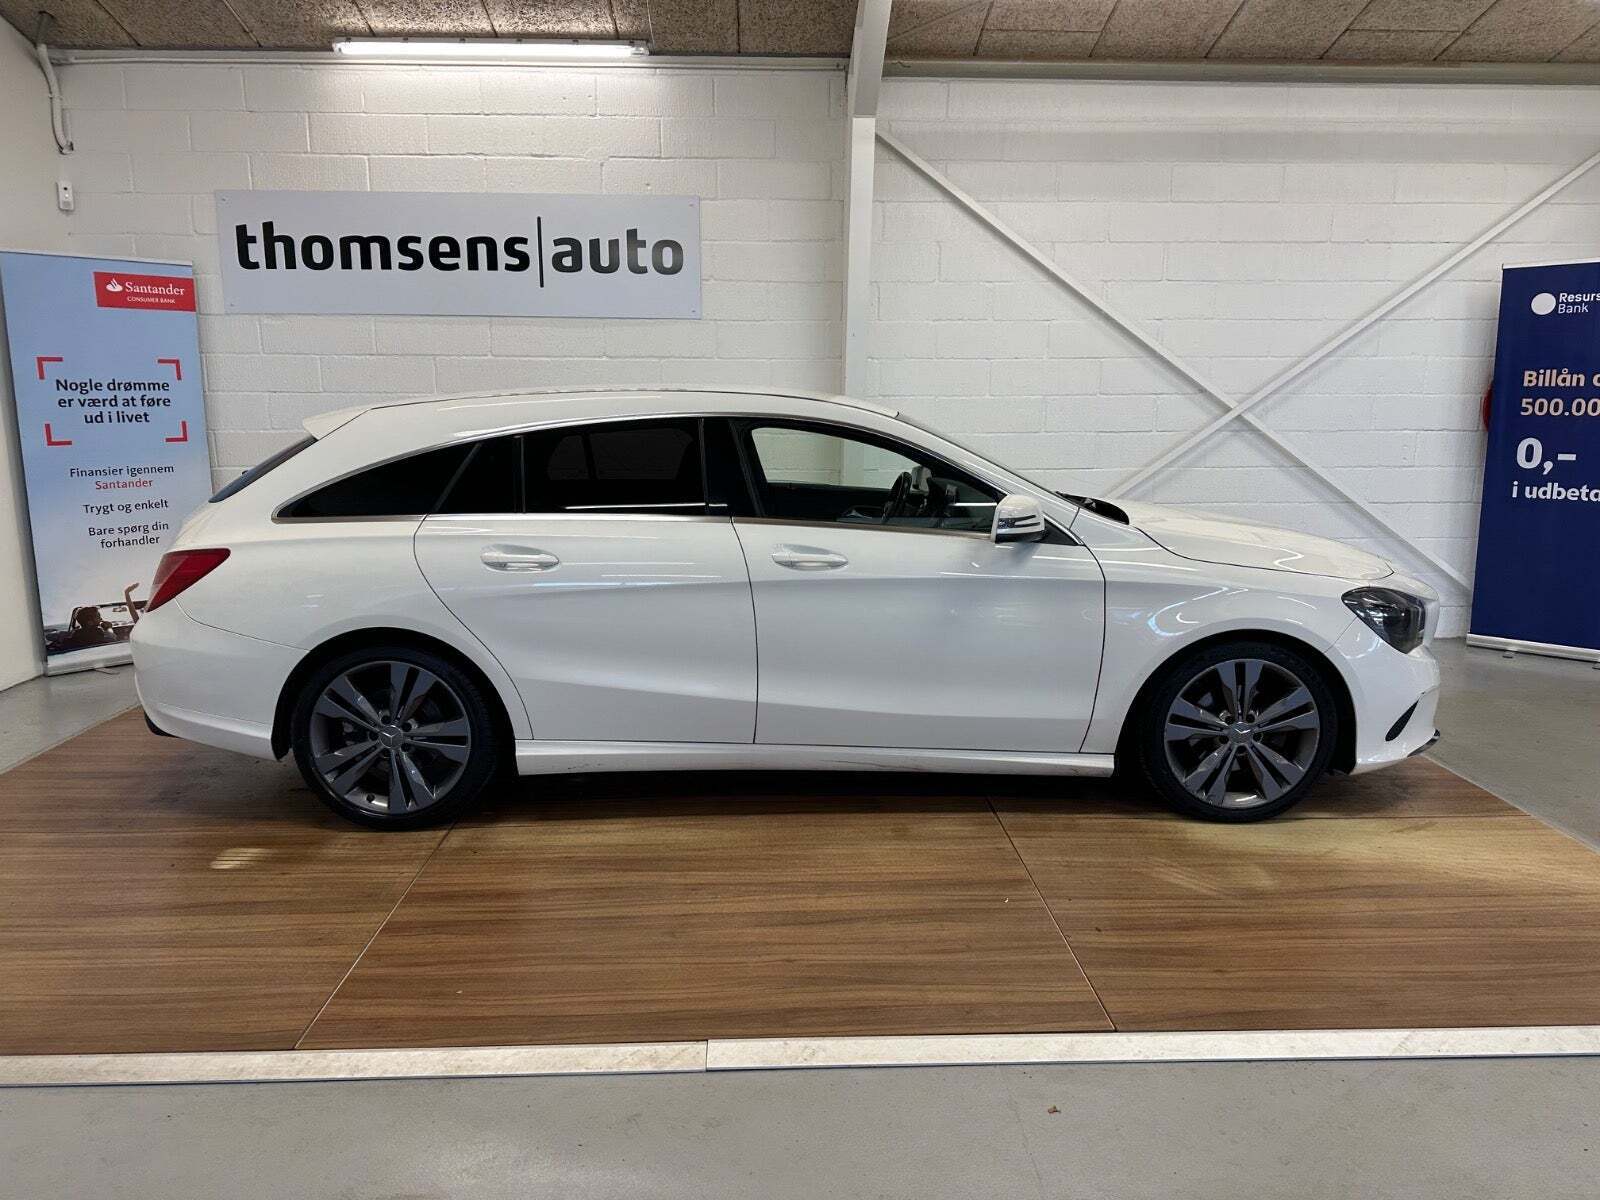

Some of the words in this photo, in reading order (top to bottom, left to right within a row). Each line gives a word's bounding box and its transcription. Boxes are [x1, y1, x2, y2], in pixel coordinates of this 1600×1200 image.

[551, 228, 684, 276] auto
[125, 281, 185, 296] Santander
[126, 295, 159, 303] CONSUMER
[1559, 292, 1600, 303] Resurs
[1558, 302, 1589, 314] Bank
[1523, 367, 1586, 387] Billån
[56, 378, 103, 394] Nogle
[106, 379, 170, 392] drømme
[58, 397, 74, 408] er
[80, 394, 118, 408] værd
[121, 395, 138, 407] at
[140, 394, 171, 408] føre
[1520, 398, 1600, 417] 500.00
[84, 411, 104, 424] ud
[108, 411, 113, 424] i
[116, 411, 151, 423] livet
[70, 466, 123, 478] Finansier
[126, 465, 175, 477] igennem
[95, 479, 154, 490] Santander
[1511, 480, 1519, 498] i
[83, 502, 114, 515] Trygt
[118, 503, 133, 514] og
[134, 499, 169, 511] enkelt
[88, 526, 115, 536] Bare
[117, 524, 150, 535] spørg
[151, 521, 169, 532] din
[100, 535, 161, 549] forhandler
